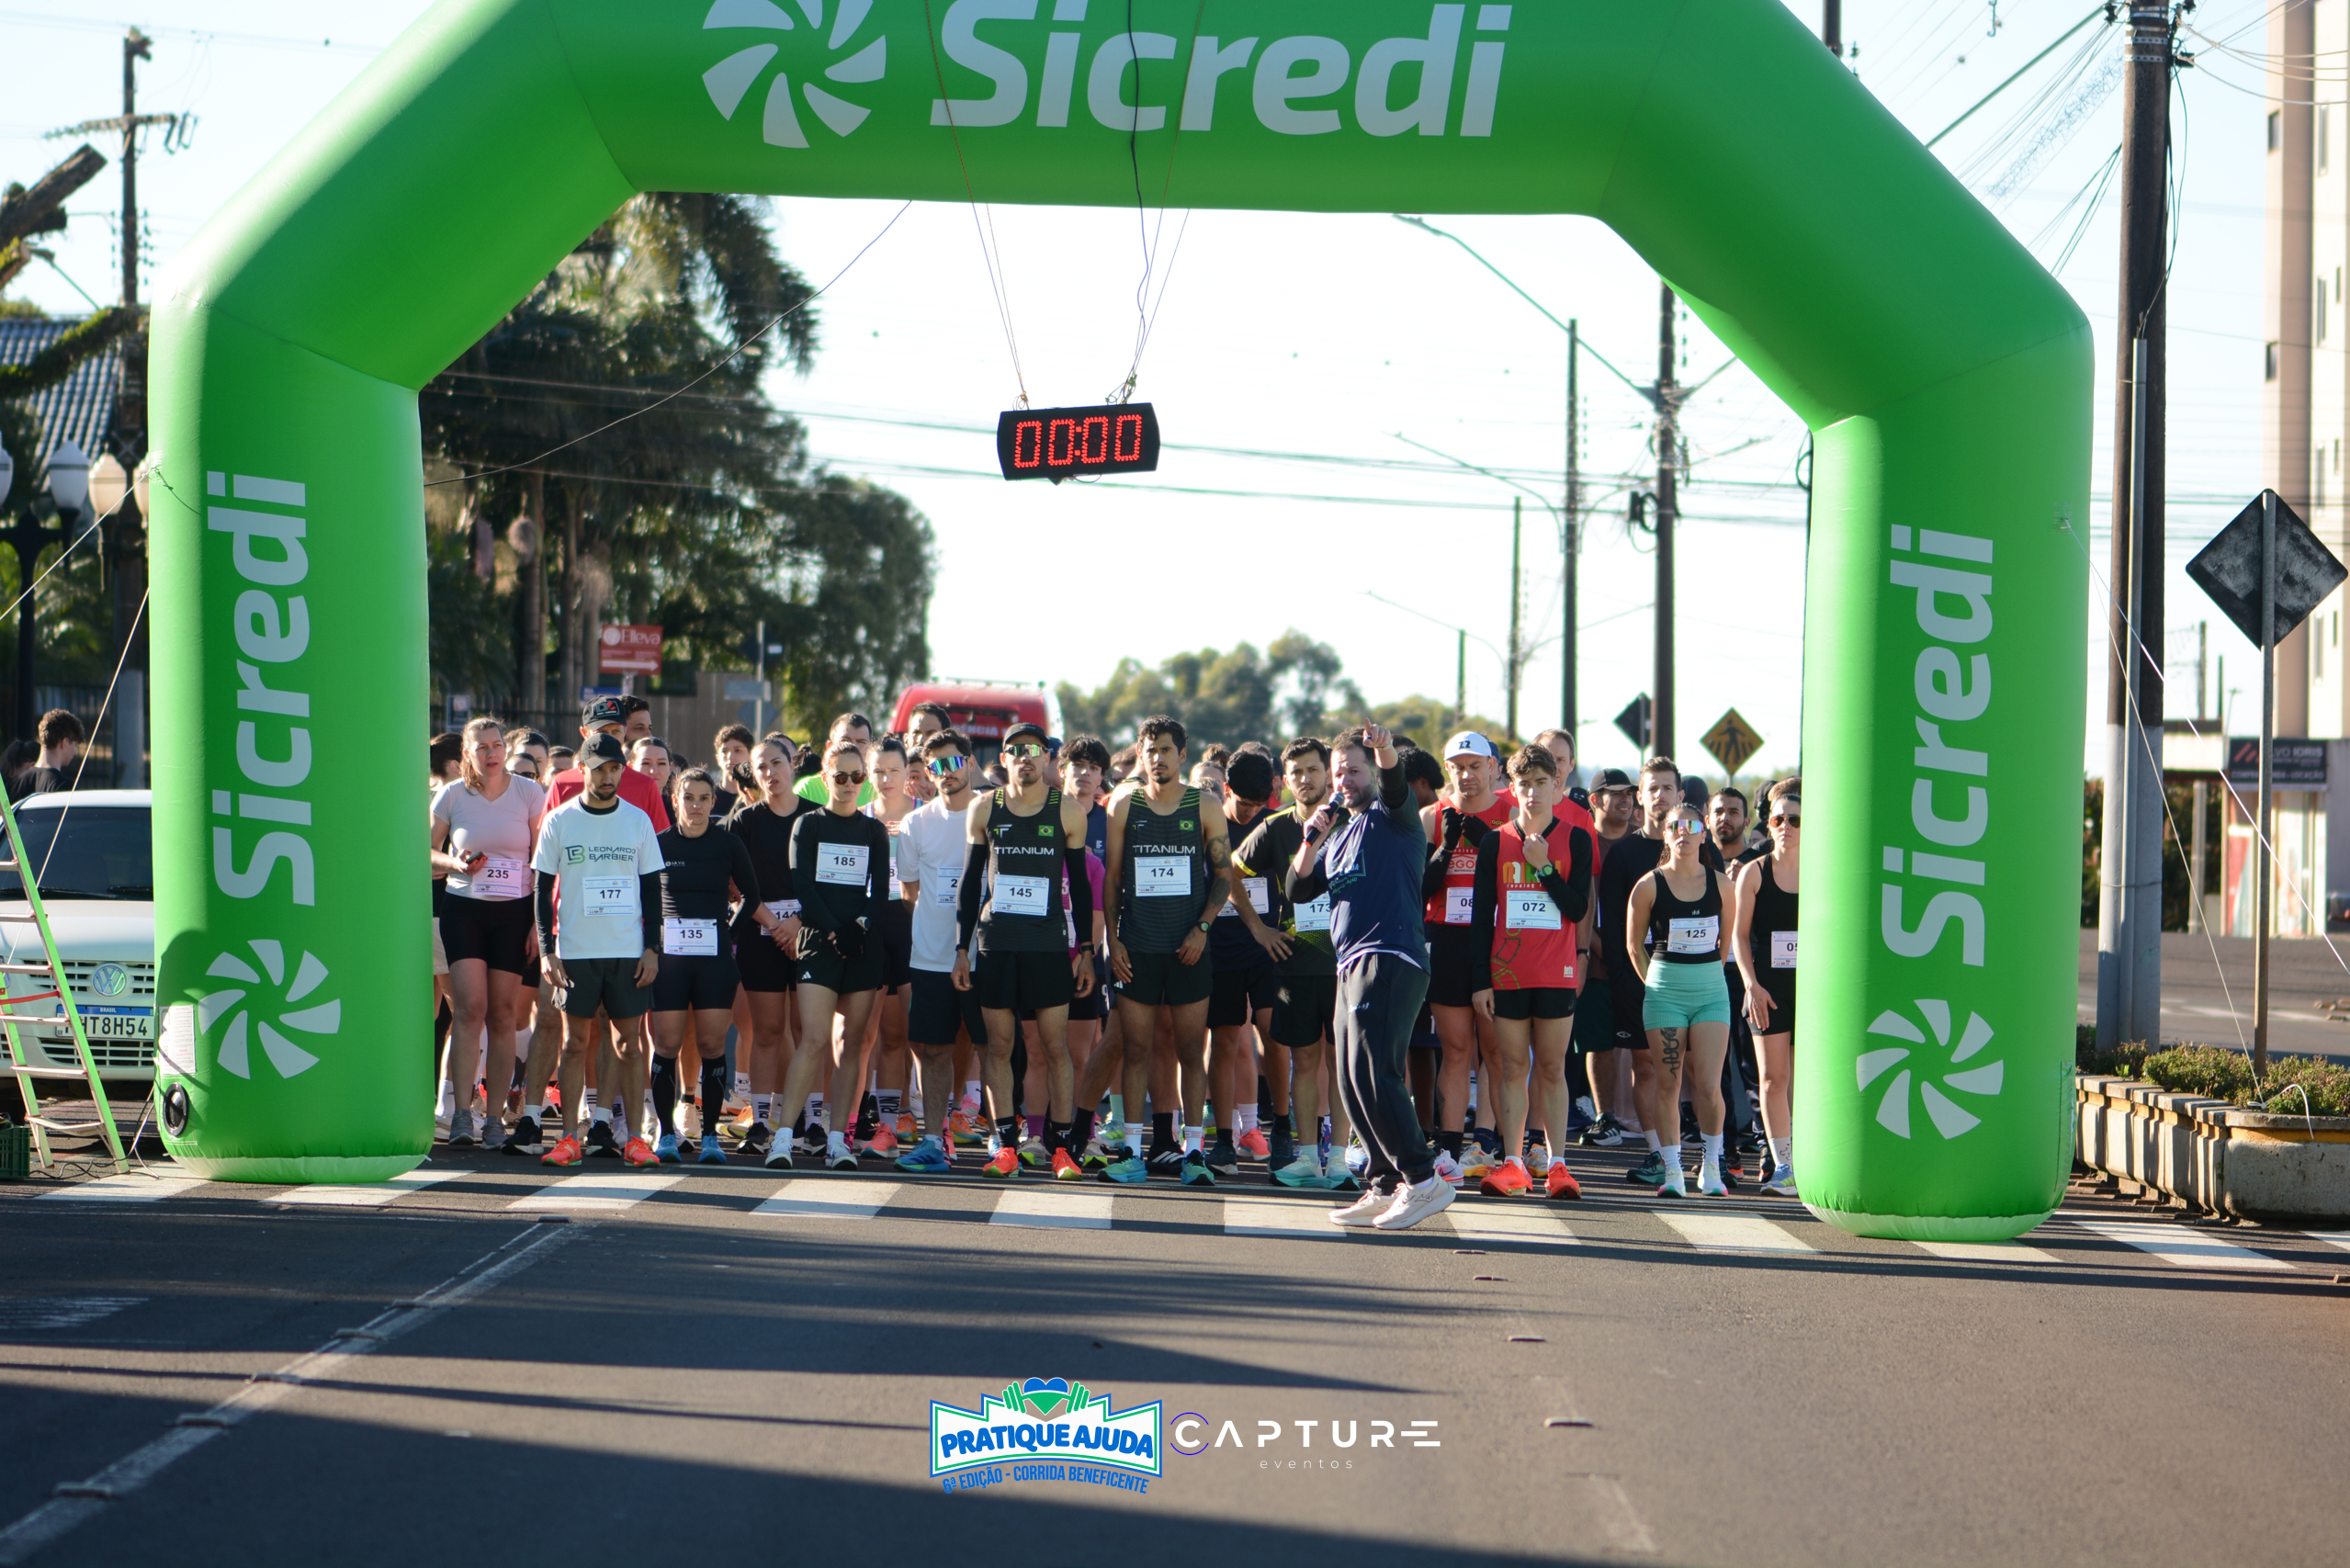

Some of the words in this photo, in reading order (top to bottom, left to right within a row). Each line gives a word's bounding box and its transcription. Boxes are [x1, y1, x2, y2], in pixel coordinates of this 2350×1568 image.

[930, 0, 1513, 137] Sicredi
[1014, 414, 1142, 468] 00:00
[621, 629, 661, 645] Elleva
[208, 470, 316, 907] Sicredi
[1881, 524, 1994, 967] Sicredi
[589, 846, 636, 854] LEONARDO
[994, 847, 1054, 855] TITANIUM
[1133, 844, 1195, 854] TITANIUM
[589, 853, 634, 863] BARBIER
[833, 856, 856, 866] 185
[487, 869, 509, 879] 235
[1150, 867, 1174, 877] 174
[600, 889, 621, 899] 177
[1010, 886, 1033, 897] 145
[1522, 902, 1546, 912] 072
[680, 929, 703, 939] 135
[1685, 929, 1707, 939] 125
[64, 1016, 148, 1036] HT8H54
[878, 1096, 900, 1114] RUN
